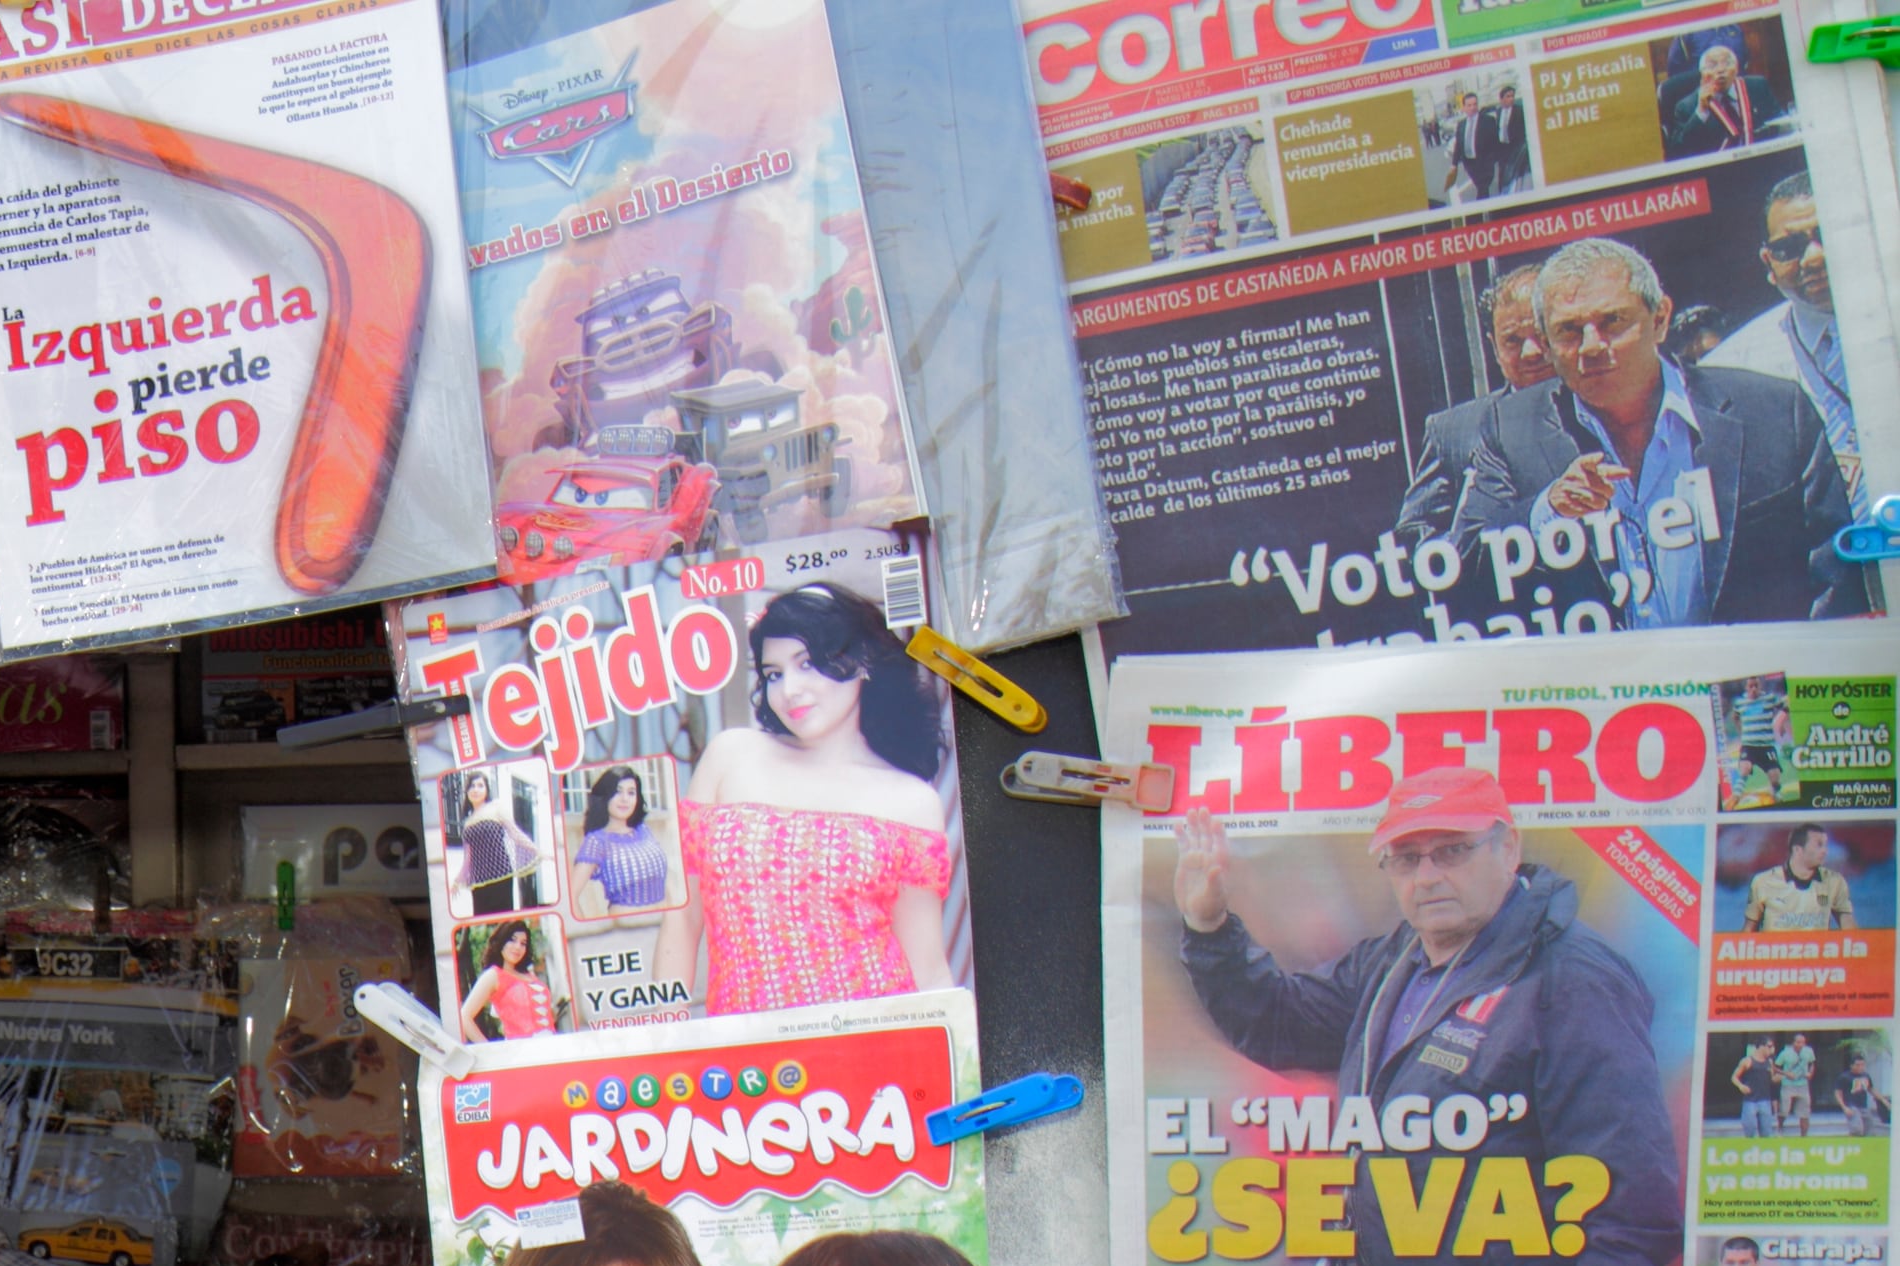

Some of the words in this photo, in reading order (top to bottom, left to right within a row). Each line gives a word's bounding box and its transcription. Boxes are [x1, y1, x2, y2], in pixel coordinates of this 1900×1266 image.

[502, 103, 618, 152] Cars
[1280, 115, 1353, 144] Chehade
[1283, 135, 1360, 163] renuncia
[6, 188, 40, 202] caída
[43, 184, 62, 198] del
[65, 176, 120, 196] gabinete
[570, 210, 609, 239] en
[620, 189, 648, 224] el
[653, 149, 793, 210] Desierto
[1441, 212, 1567, 257] REVOCATORIA
[1571, 204, 1596, 228] DE
[1602, 184, 1698, 226] VILLARÁN
[1224, 263, 1328, 299] CASTAÑEDA
[1332, 259, 1346, 277] A
[1350, 250, 1408, 274] FAVOR
[1413, 243, 1436, 262] DE
[2, 307, 24, 322] La
[3, 274, 317, 377] Izquierda
[128, 347, 271, 415] pierde
[16, 389, 260, 527] piso
[1478, 510, 1626, 589] por
[1645, 468, 1723, 552] el
[688, 564, 728, 597] No.
[732, 561, 759, 590] 10
[418, 586, 736, 772] Tejido
[1150, 704, 1245, 721] www.libero.pe
[1808, 723, 1889, 746] André
[1144, 704, 1707, 818] LÍBERO
[1792, 745, 1891, 769] Carrillo
[582, 951, 642, 978] TEJE
[588, 989, 605, 1014] Y
[609, 978, 689, 1009] GANA
[70, 1023, 115, 1047] York
[1150, 1097, 1228, 1154] EL
[1147, 1158, 1356, 1264] ¿SE
[1369, 1157, 1609, 1258] VA?
[1762, 1238, 1882, 1262] Charapa
